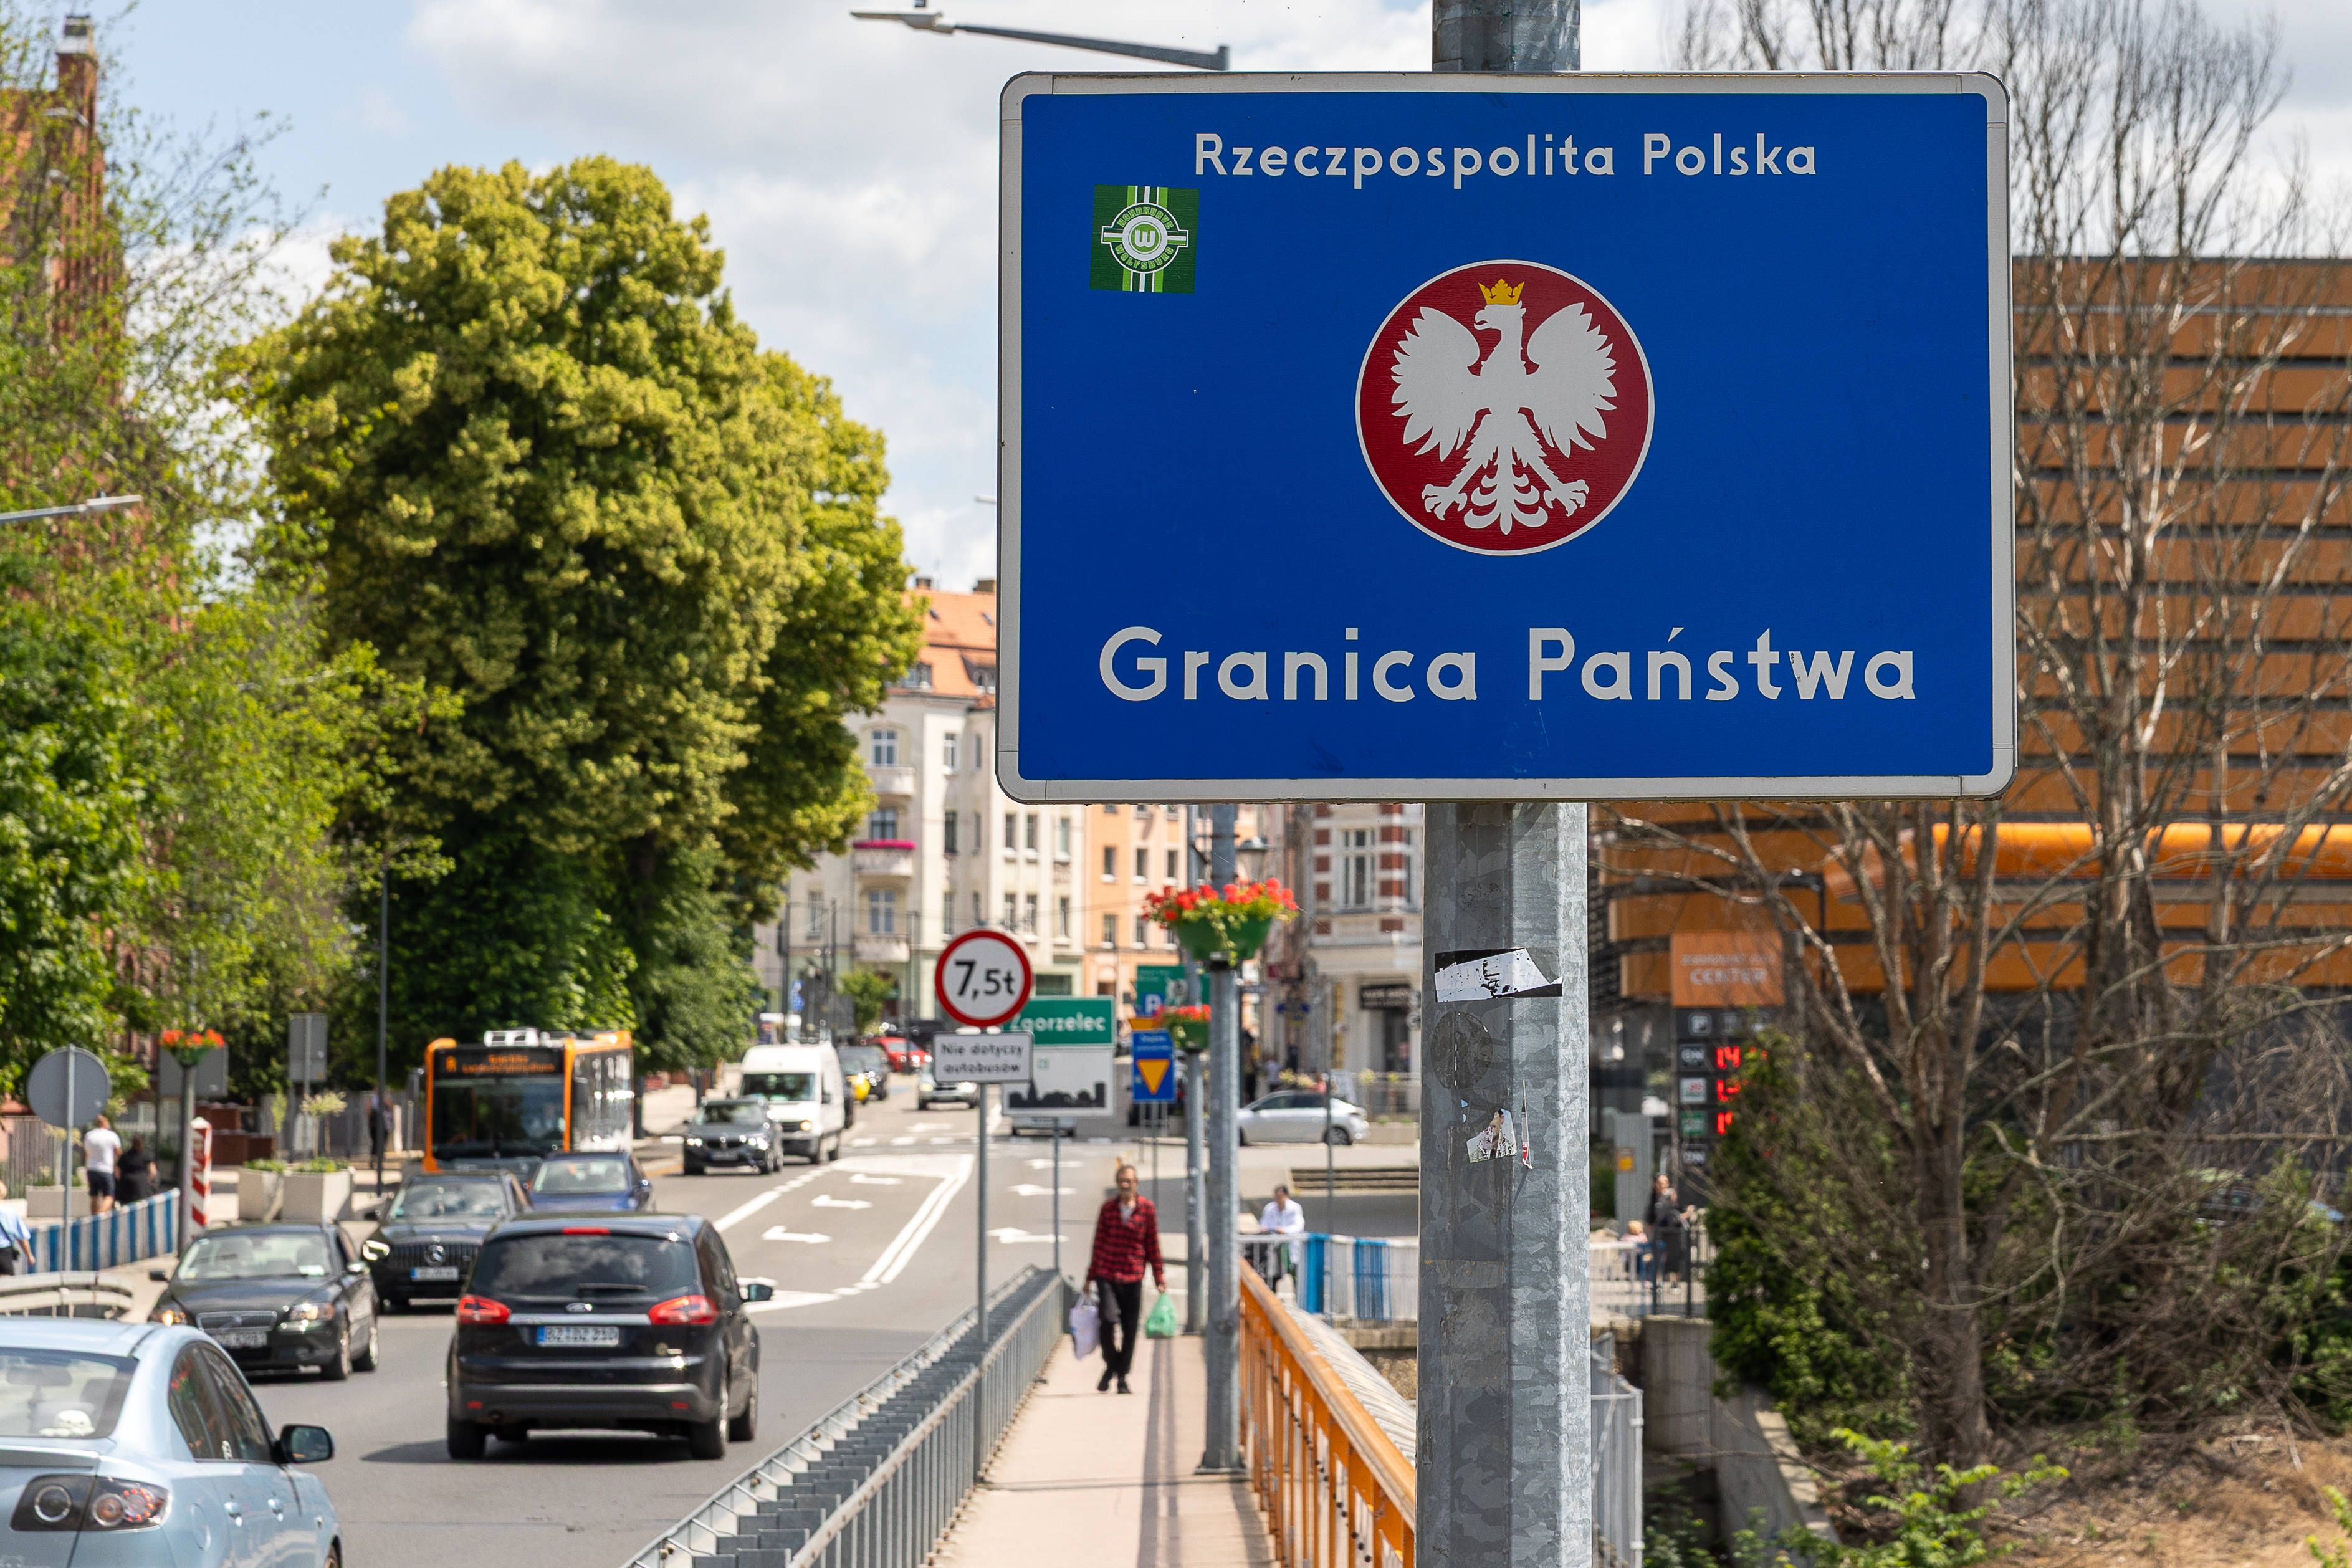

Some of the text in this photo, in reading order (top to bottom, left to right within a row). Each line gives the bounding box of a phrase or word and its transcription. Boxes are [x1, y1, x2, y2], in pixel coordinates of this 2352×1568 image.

[1195, 132, 1817, 189] Rzeczpospolita Polska
[1117, 206, 1174, 230] NORDKURVE
[1114, 244, 1174, 270] WOLFSBURG
[1099, 626, 1916, 703] Granica Państwa
[954, 959, 1016, 1001] 7,5t
[941, 1043, 1023, 1058] Nie dotyczy
[944, 1061, 1021, 1074] autobusów
